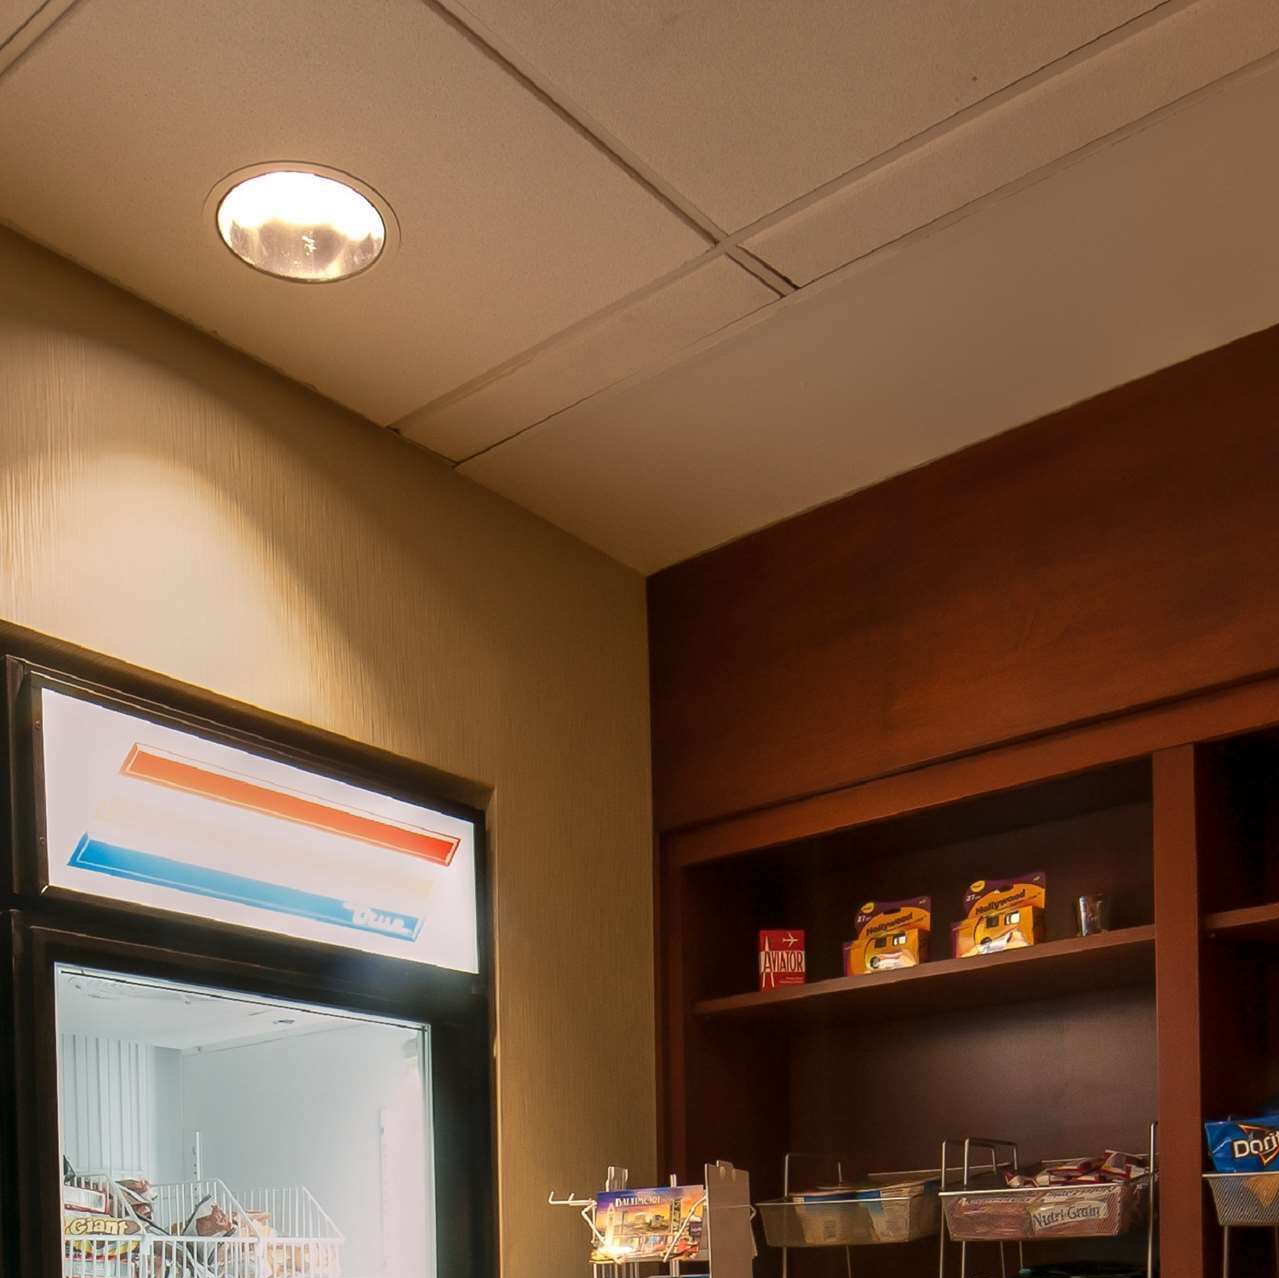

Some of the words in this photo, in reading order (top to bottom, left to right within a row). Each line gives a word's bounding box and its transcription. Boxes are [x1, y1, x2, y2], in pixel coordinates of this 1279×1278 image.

[975, 889, 1026, 914] Hollywood
[866, 913, 913, 936] Hollywood
[70, 1216, 129, 1235] Giant
